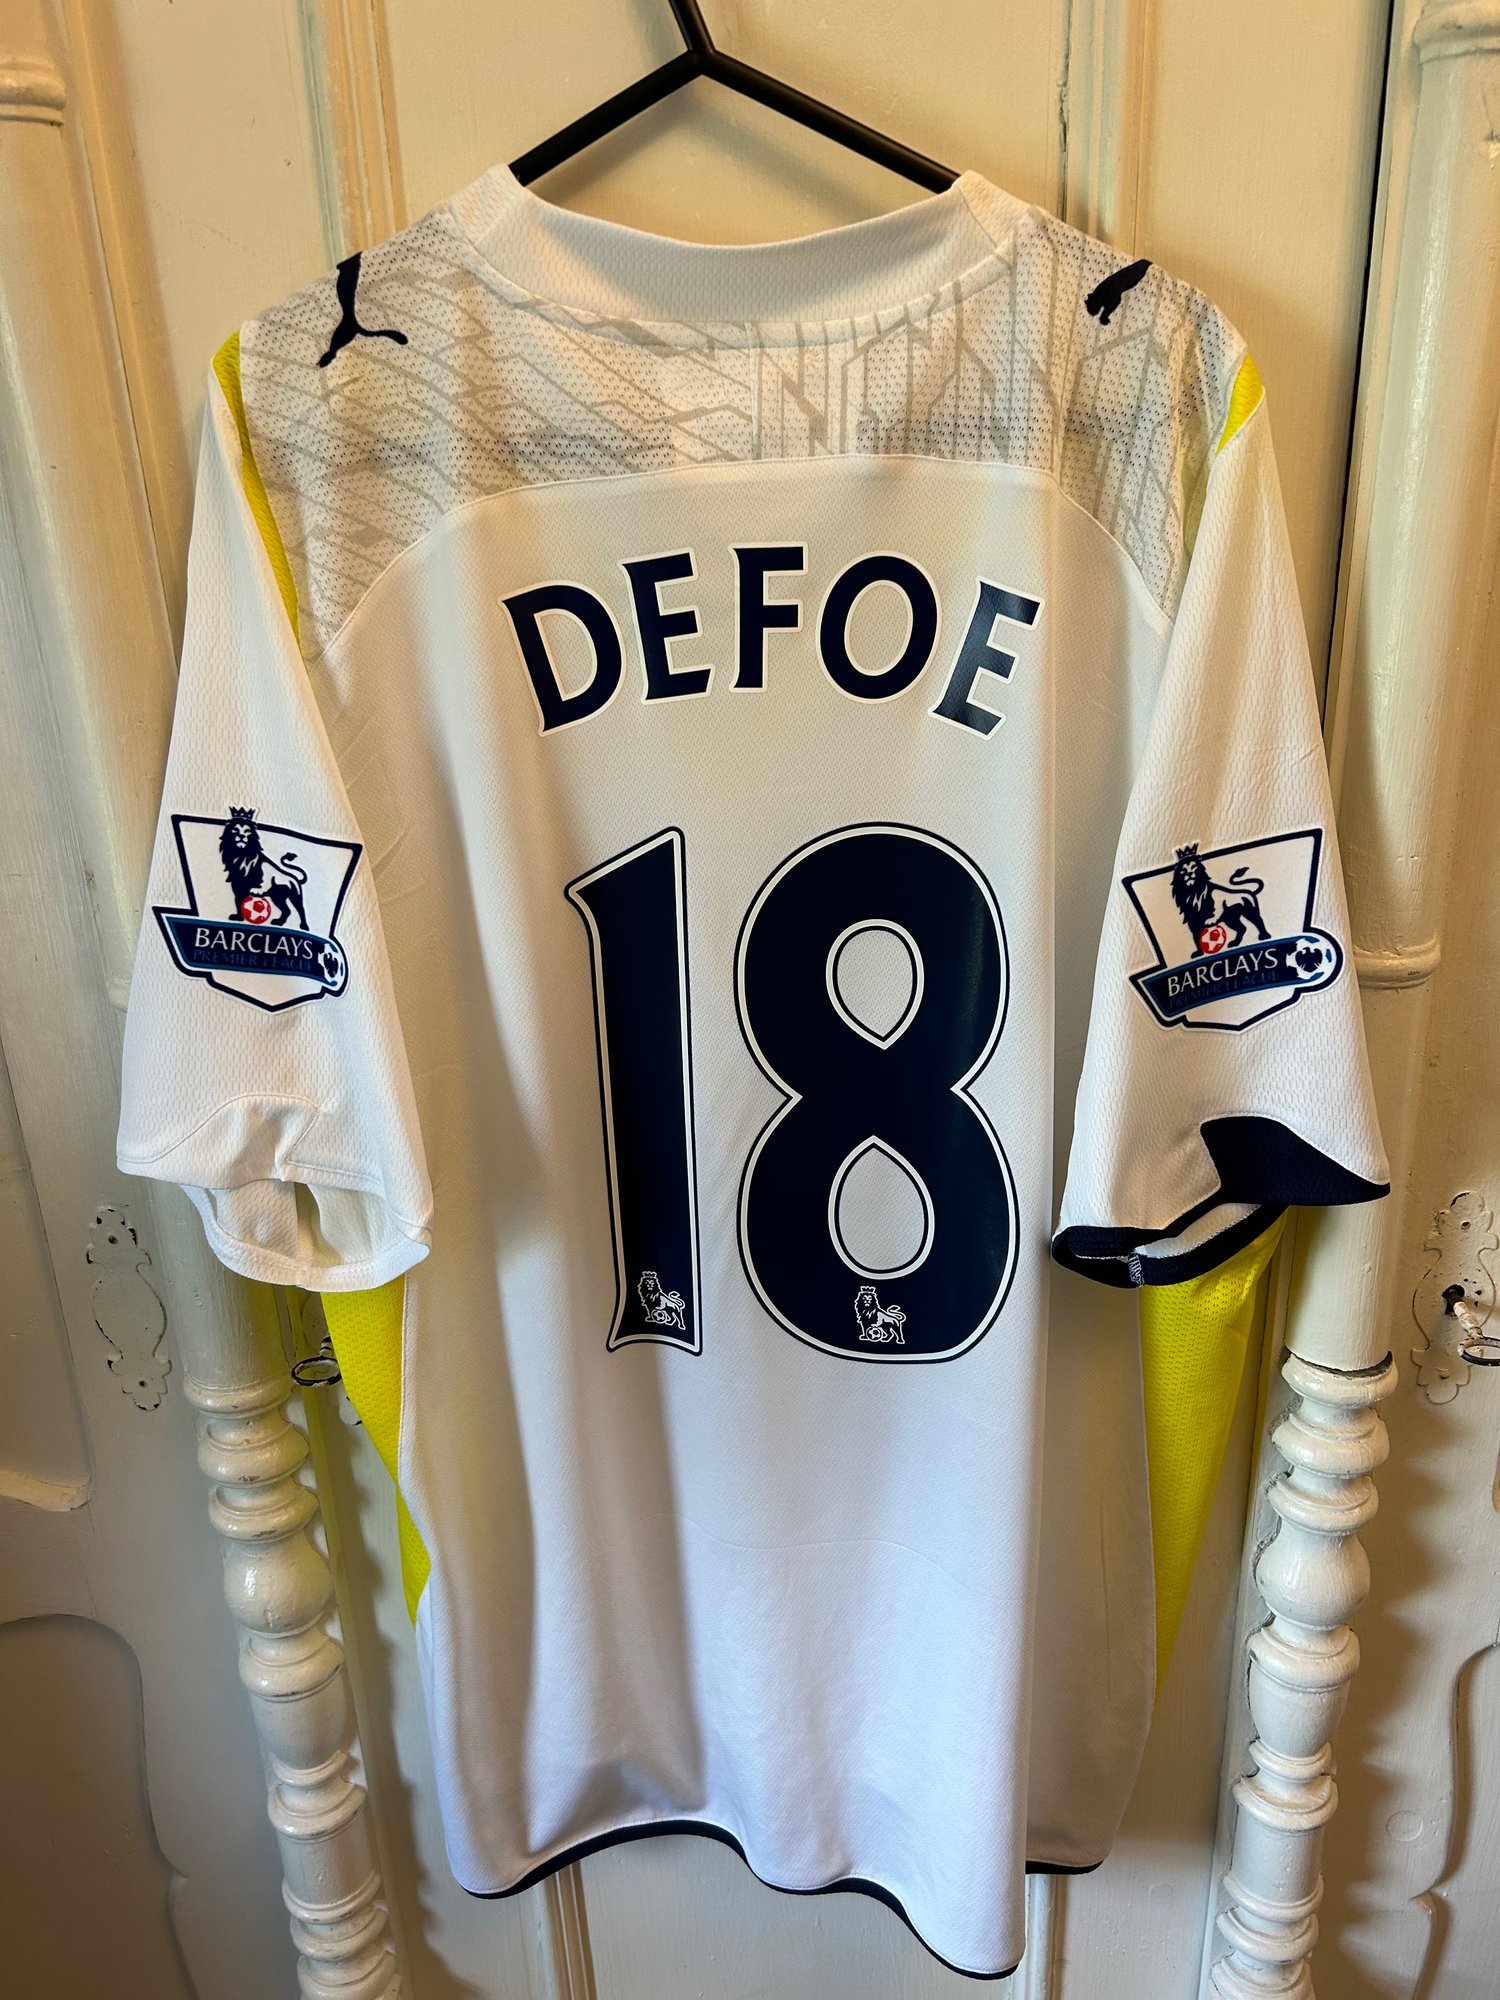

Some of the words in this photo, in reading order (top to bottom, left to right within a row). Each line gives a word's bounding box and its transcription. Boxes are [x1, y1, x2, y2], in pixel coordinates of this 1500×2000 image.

[502, 545, 1042, 737] DEFOE
[194, 927, 314, 960] BARCLAYS
[1167, 947, 1279, 997] BARCLAYS
[564, 822, 1020, 1364] 18
